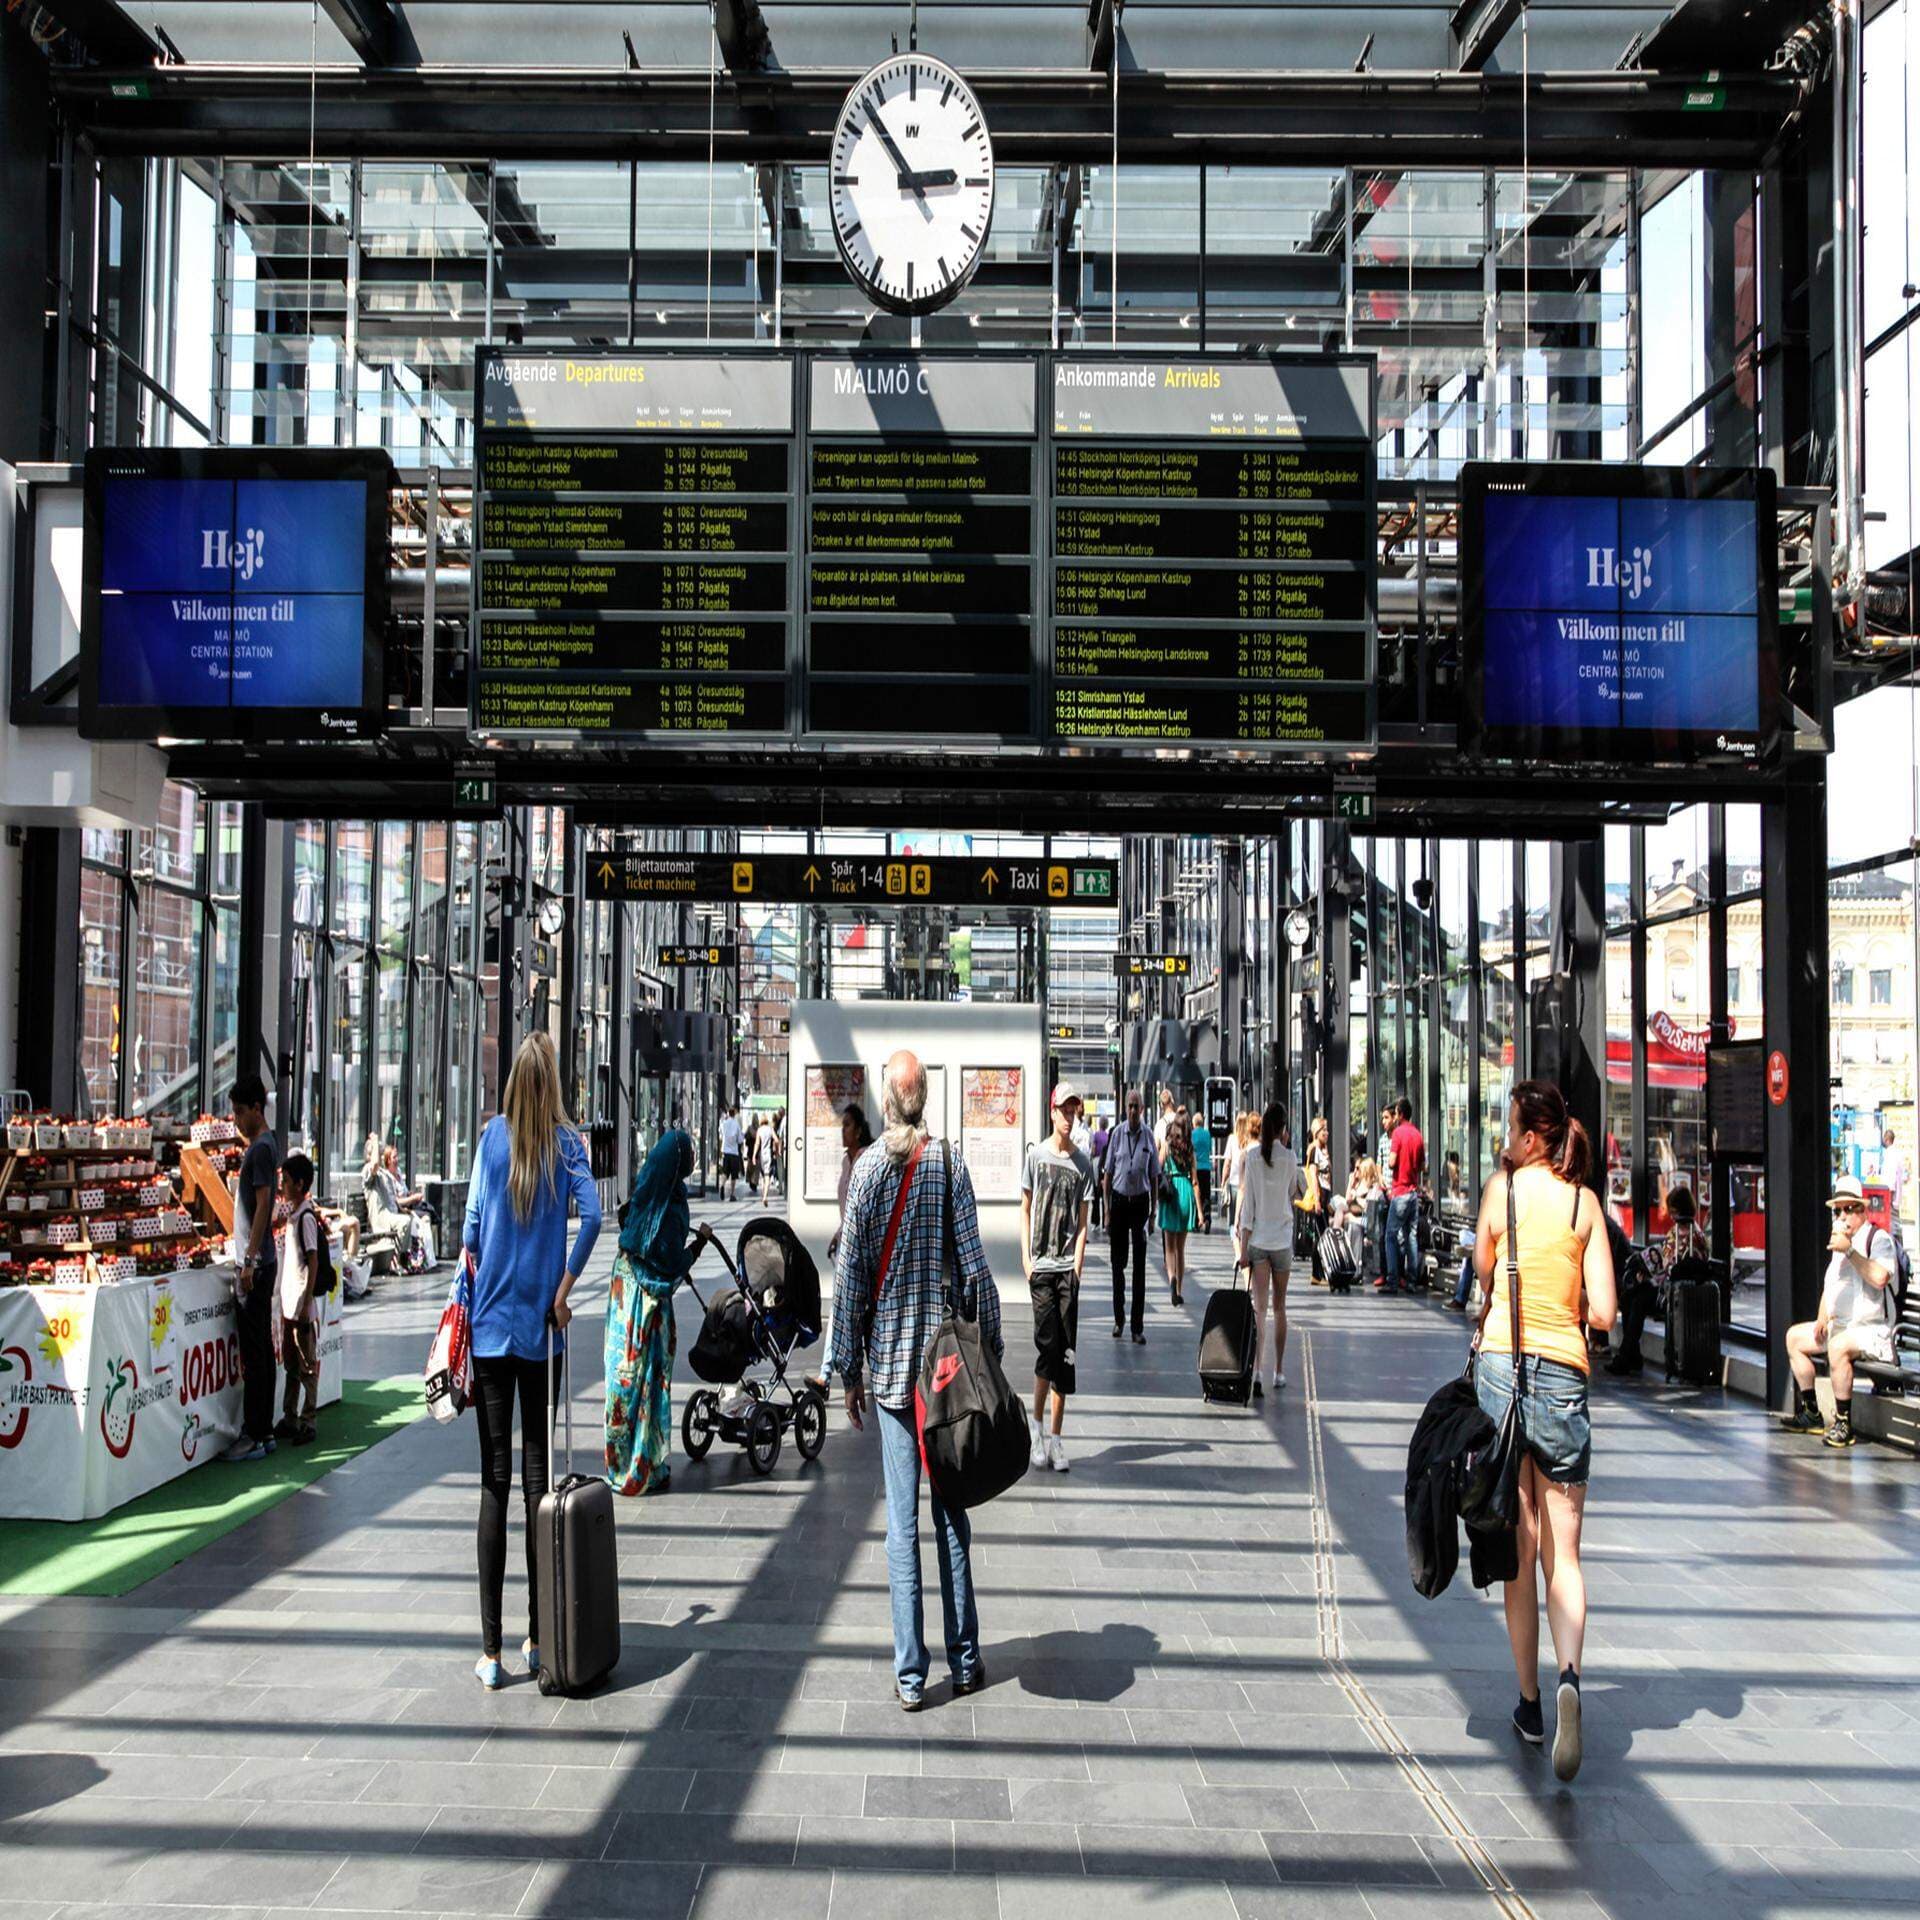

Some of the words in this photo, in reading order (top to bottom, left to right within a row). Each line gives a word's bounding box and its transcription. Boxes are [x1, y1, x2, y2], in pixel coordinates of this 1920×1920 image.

[485, 361, 557, 386] Avgående
[566, 362, 644, 387] Departures
[834, 363, 910, 394] MALMÖ
[916, 368, 929, 395] C
[1056, 366, 1156, 388] Ankommande
[1164, 367, 1221, 389] Arrivals
[532, 462, 550, 473] Lund
[201, 528, 265, 580] Hej!
[1586, 547, 1652, 599] Hej!
[172, 599, 267, 622] Välkommen
[271, 600, 294, 622] till
[214, 628, 250, 642] MAMÖ
[1557, 618, 1656, 641] Välkommen
[1661, 620, 1685, 642] till
[1603, 648, 1640, 662] MAMÖ
[1123, 691, 1145, 703] Ystad
[1168, 709, 1188, 721] Lund
[625, 858, 695, 875] Biljettautomat
[831, 860, 853, 879] Spår
[860, 865, 884, 888] 1-4
[625, 876, 653, 890] Ticket
[656, 877, 697, 891] machine
[831, 879, 857, 893] Track
[1009, 867, 1040, 890] Taxi
[154, 1305, 167, 1326] 30
[49, 1318, 71, 1339] 30
